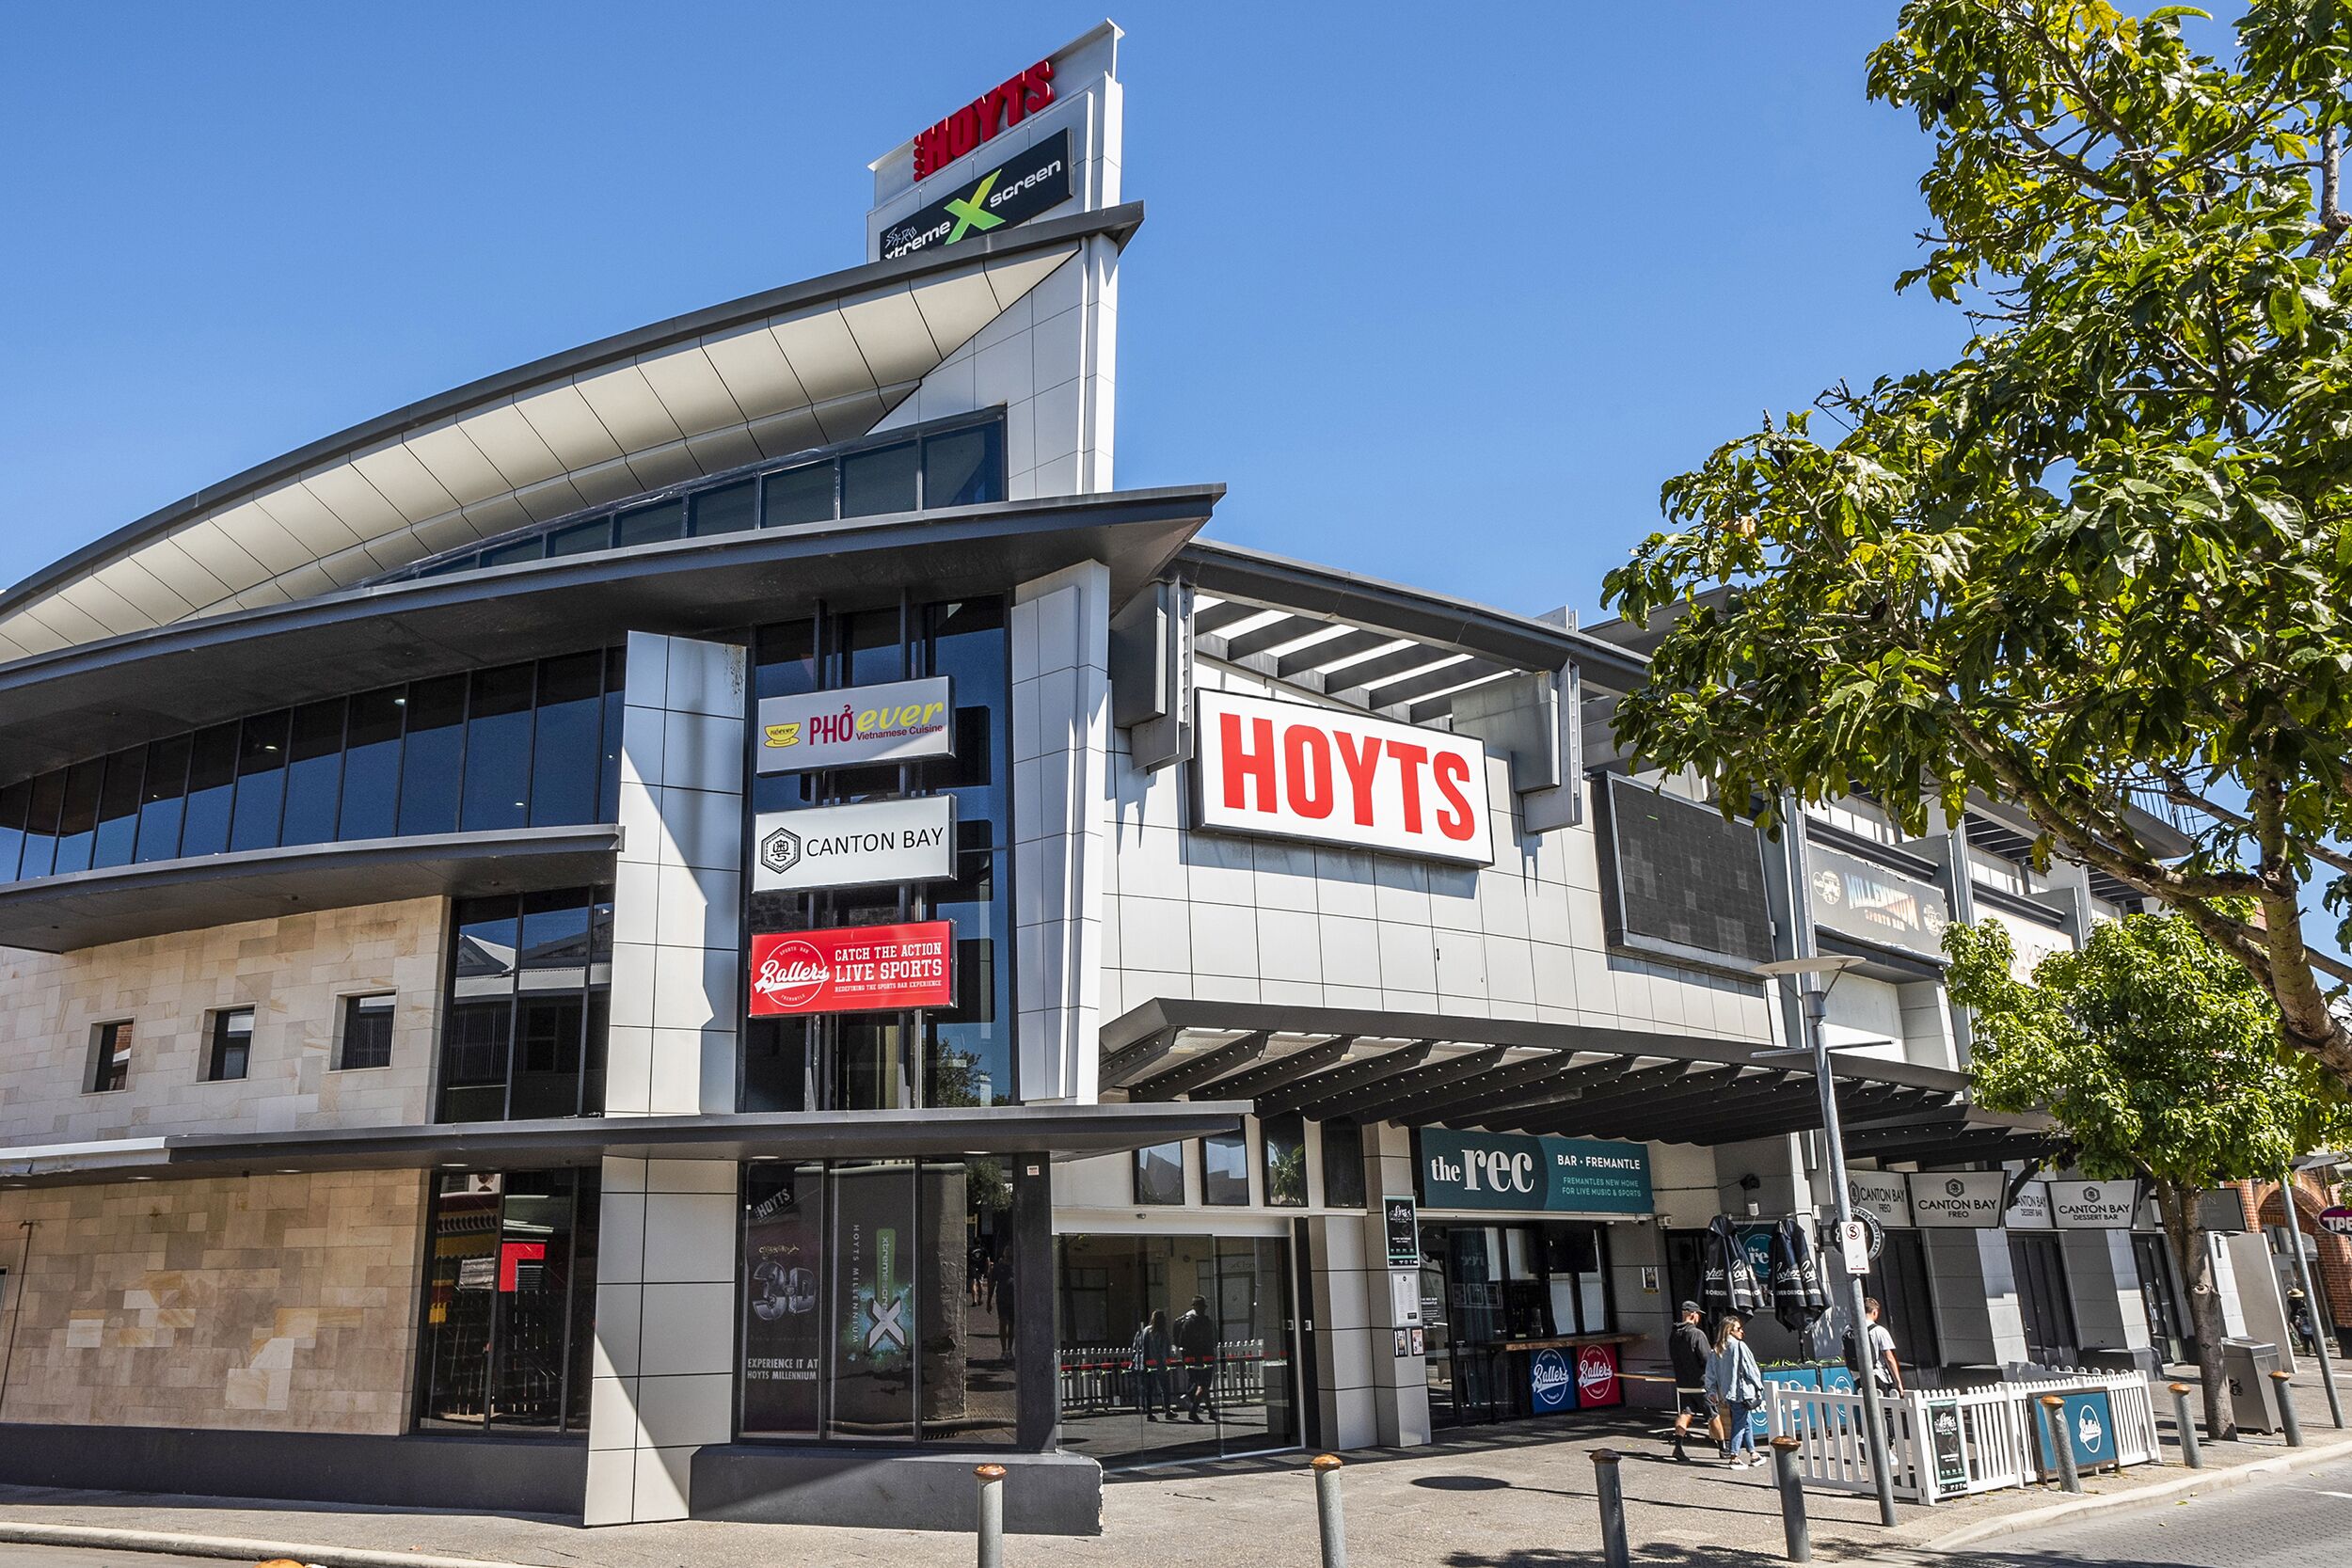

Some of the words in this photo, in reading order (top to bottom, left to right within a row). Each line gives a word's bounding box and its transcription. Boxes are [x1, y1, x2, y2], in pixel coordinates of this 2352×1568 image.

[914, 59, 1055, 182] HOYTS
[990, 159, 1061, 208] screen
[856, 702, 944, 732] ever
[856, 729, 908, 741] Vietnamese
[909, 725, 944, 736] Cuisine
[1220, 713, 1475, 841] HOYTS
[806, 832, 895, 857] CANTON
[903, 827, 944, 848] BAY
[834, 947, 870, 961] CATCH
[874, 945, 898, 959] THE
[900, 942, 942, 958] ACTION
[756, 959, 830, 992] Ballers
[834, 963, 875, 983] LIVE
[880, 958, 943, 979] SPORTS
[834, 984, 866, 992] REDEFINING
[1430, 1156, 1461, 1181] the
[1461, 1149, 1534, 1193] rec
[1557, 1155, 1578, 1166] BAR
[1585, 1156, 1641, 1169] FREMANTLE
[1563, 1177, 1604, 1186] FREMANTLES
[1605, 1179, 1619, 1187] NEW
[756, 1188, 790, 1218] HOYTS
[1860, 1187, 1891, 1201] CANTON
[1892, 1189, 1905, 1203] BAY
[1918, 1199, 1971, 1210] CANTON
[1974, 1199, 1996, 1210] BAY
[2058, 1205, 2106, 1213] CANTON
[2109, 1204, 2130, 1213] BAY
[1750, 1250, 1769, 1264] re
[747, 1358, 793, 1369] EXPERIENCE
[796, 1358, 803, 1369] IT
[807, 1358, 818, 1369] AT
[1579, 1359, 1613, 1387] Ballers
[747, 1370, 770, 1380] HOYTS
[771, 1370, 817, 1380] MILLENNIUM
[1533, 1364, 1568, 1393] Ballers
